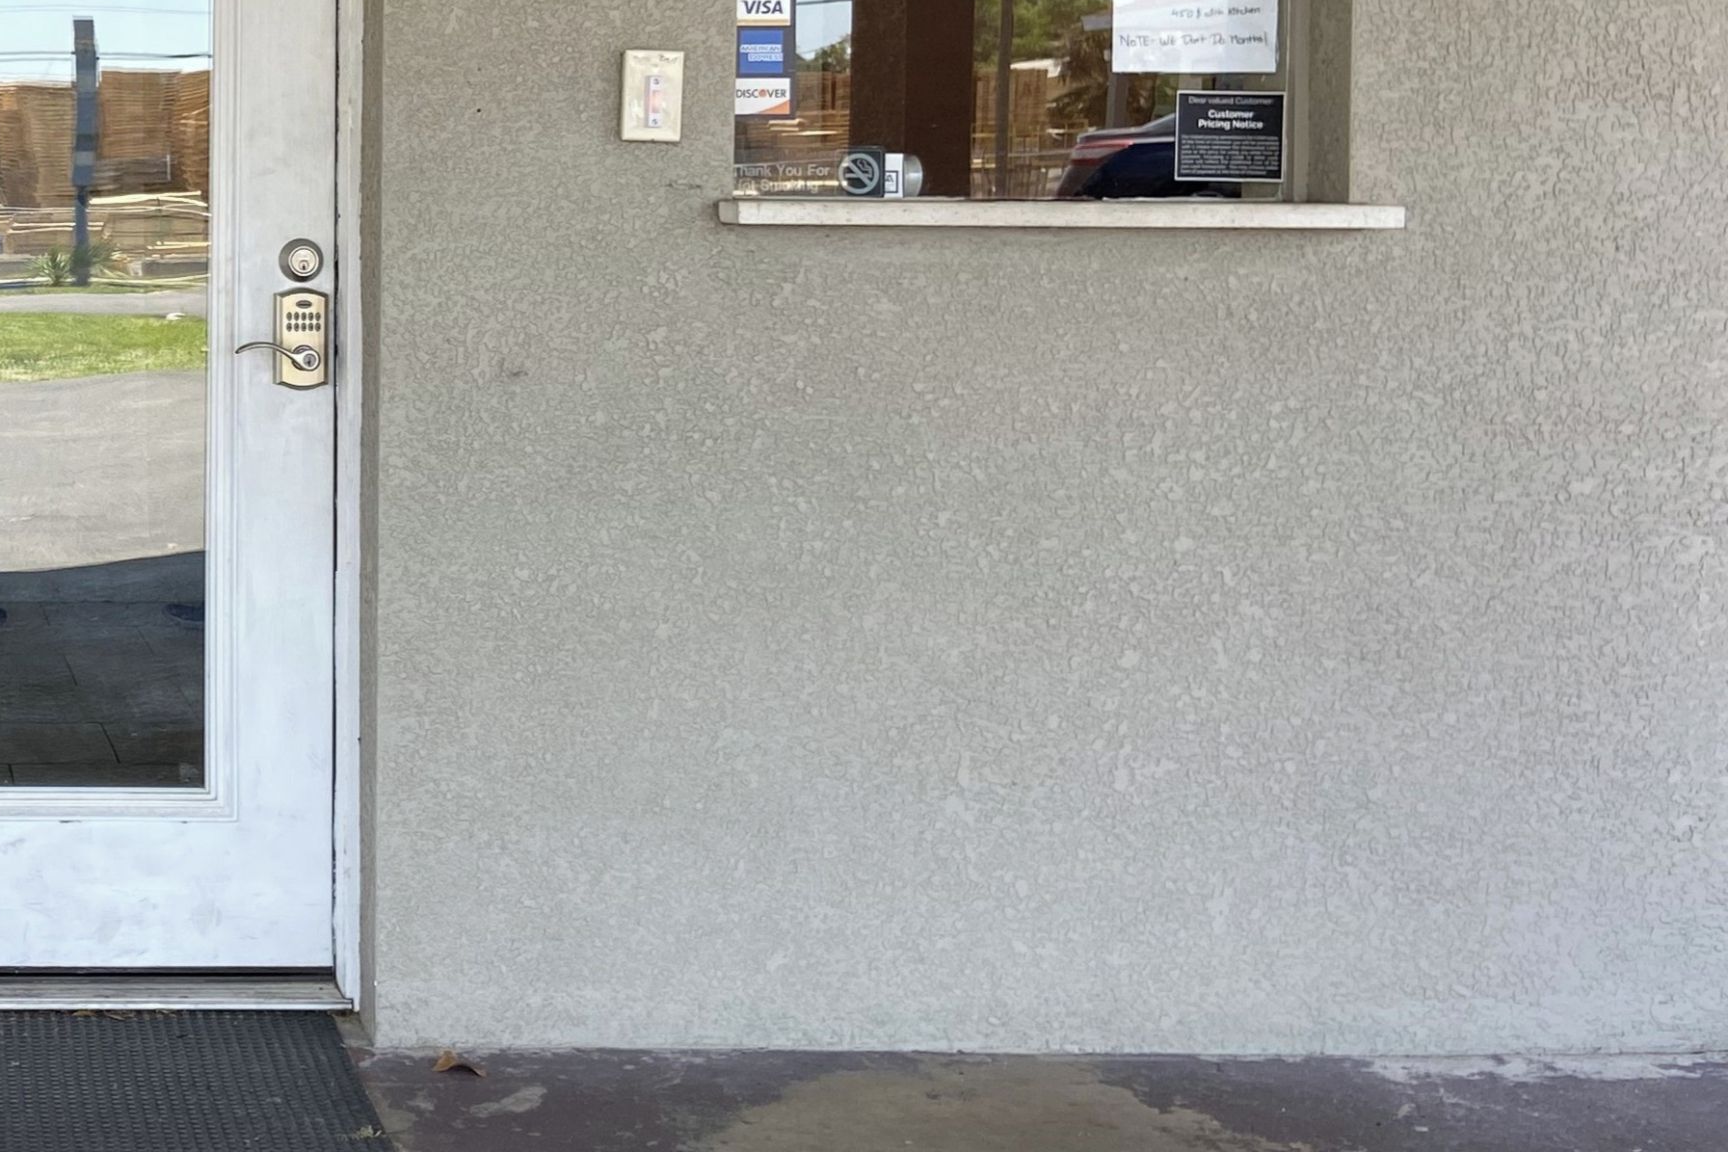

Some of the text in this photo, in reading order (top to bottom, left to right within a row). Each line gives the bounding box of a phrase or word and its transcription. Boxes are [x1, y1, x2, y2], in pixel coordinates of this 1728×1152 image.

[742, 0, 784, 15] VISA
[740, 44, 783, 53] AMERICAN
[747, 53, 783, 62] EXPRESS
[735, 89, 787, 98] DISCOVER
[1188, 96, 1207, 104] Dear
[1207, 109, 1254, 119] Customer
[1197, 119, 1264, 131] Pricing Notice
[775, 162, 802, 177] You
[807, 163, 831, 177] For
[760, 179, 819, 194] Smoking
